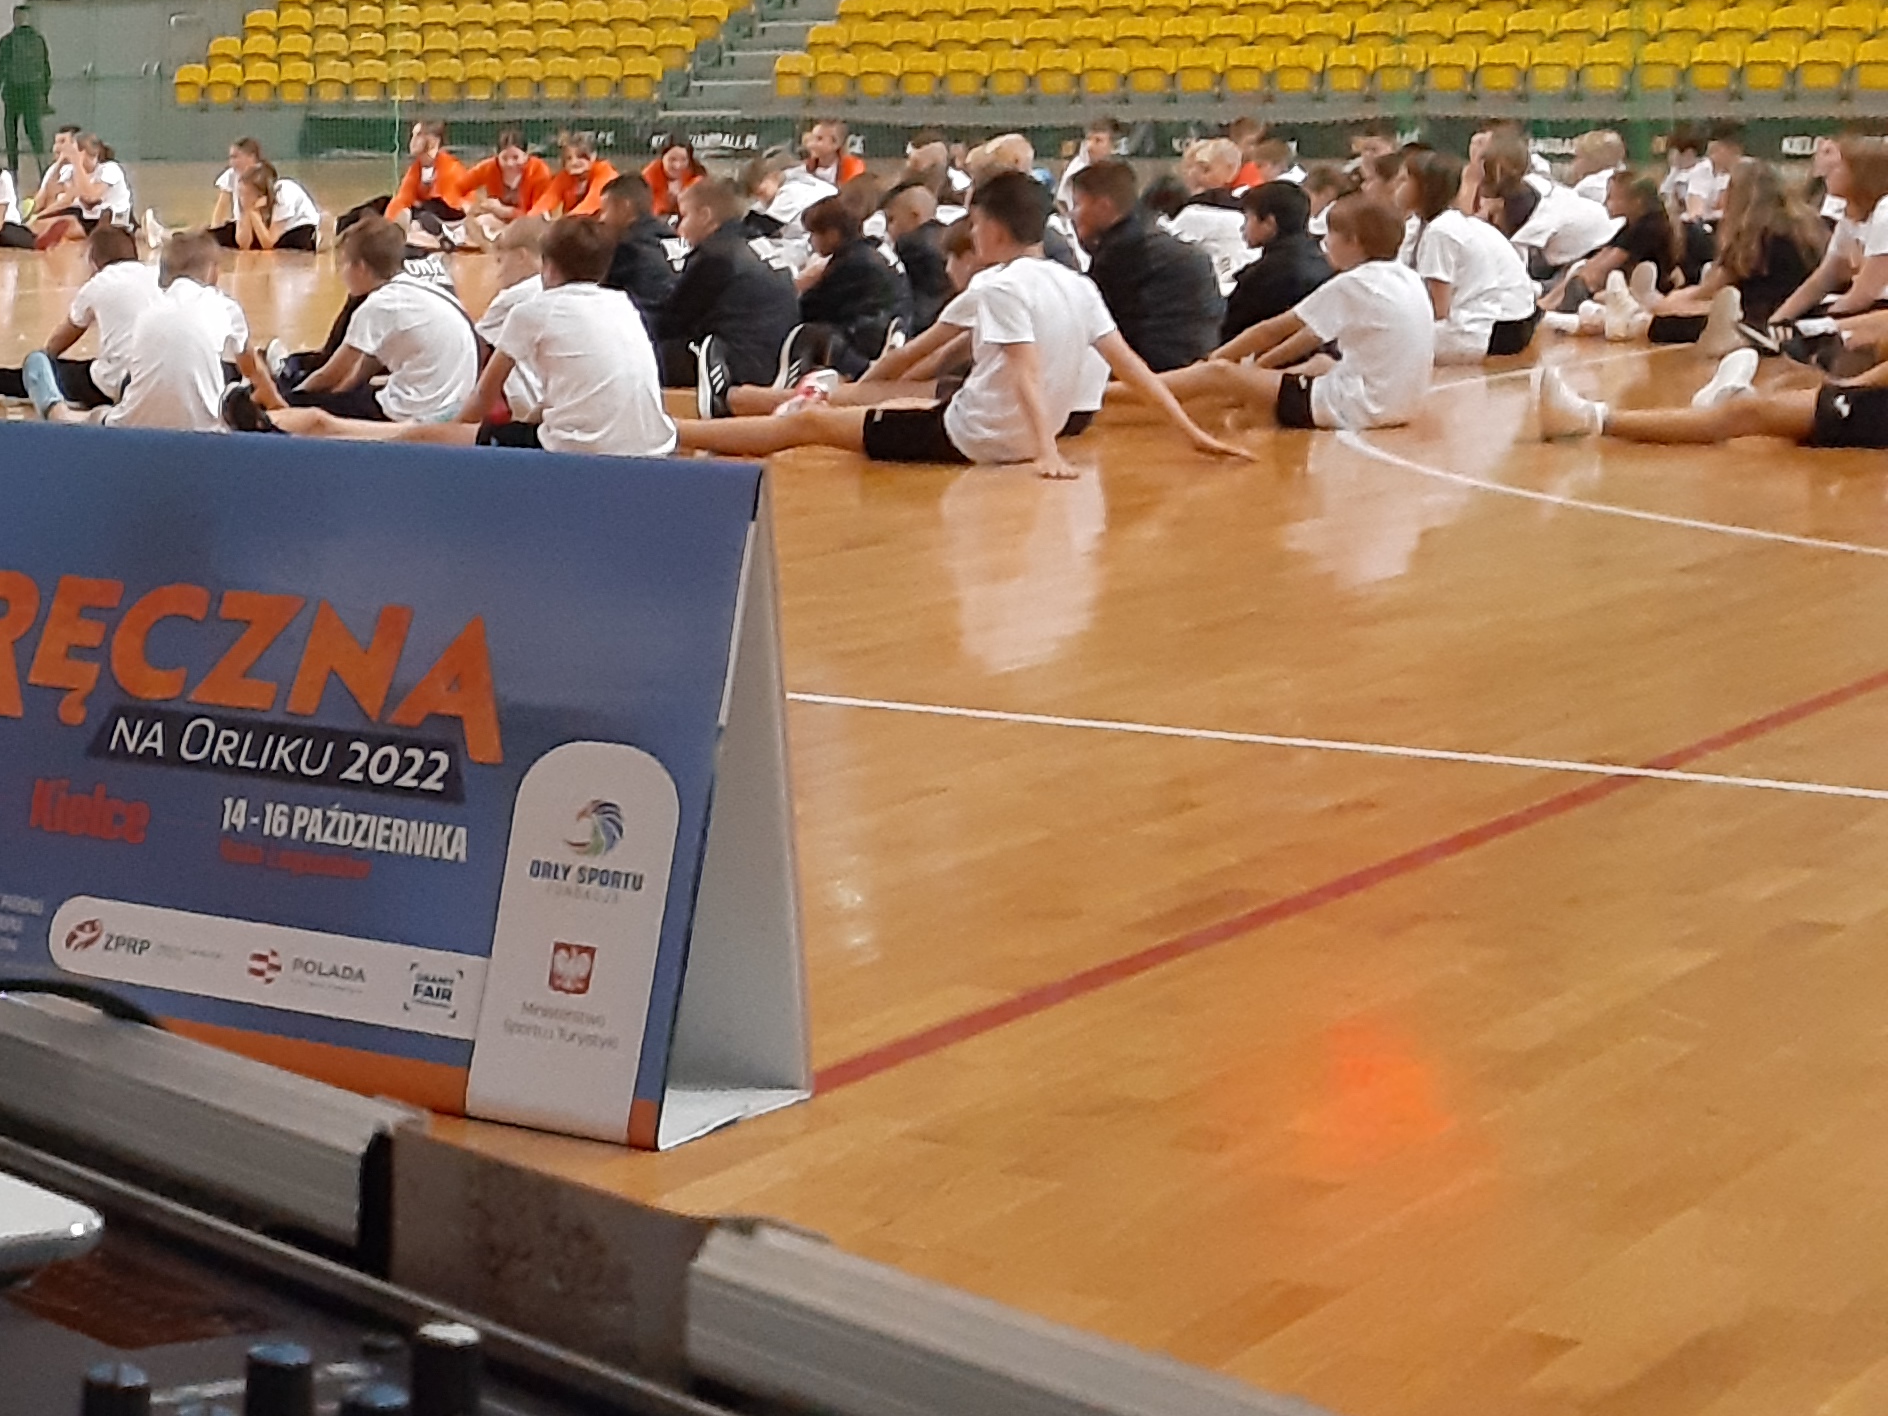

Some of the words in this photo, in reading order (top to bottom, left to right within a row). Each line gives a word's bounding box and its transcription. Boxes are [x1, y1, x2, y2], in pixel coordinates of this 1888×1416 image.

[109, 716, 165, 758] NA
[178, 716, 335, 777] ORLIKU
[339, 740, 451, 793] 2022
[221, 797, 244, 833] 14
[262, 802, 290, 838] 16
[290, 801, 469, 863] PAŹDZIERNIKA
[577, 866, 646, 892] SPORTU
[103, 933, 151, 956] ZPRP
[292, 956, 367, 983] POLADA
[413, 983, 453, 1002] FAIR
